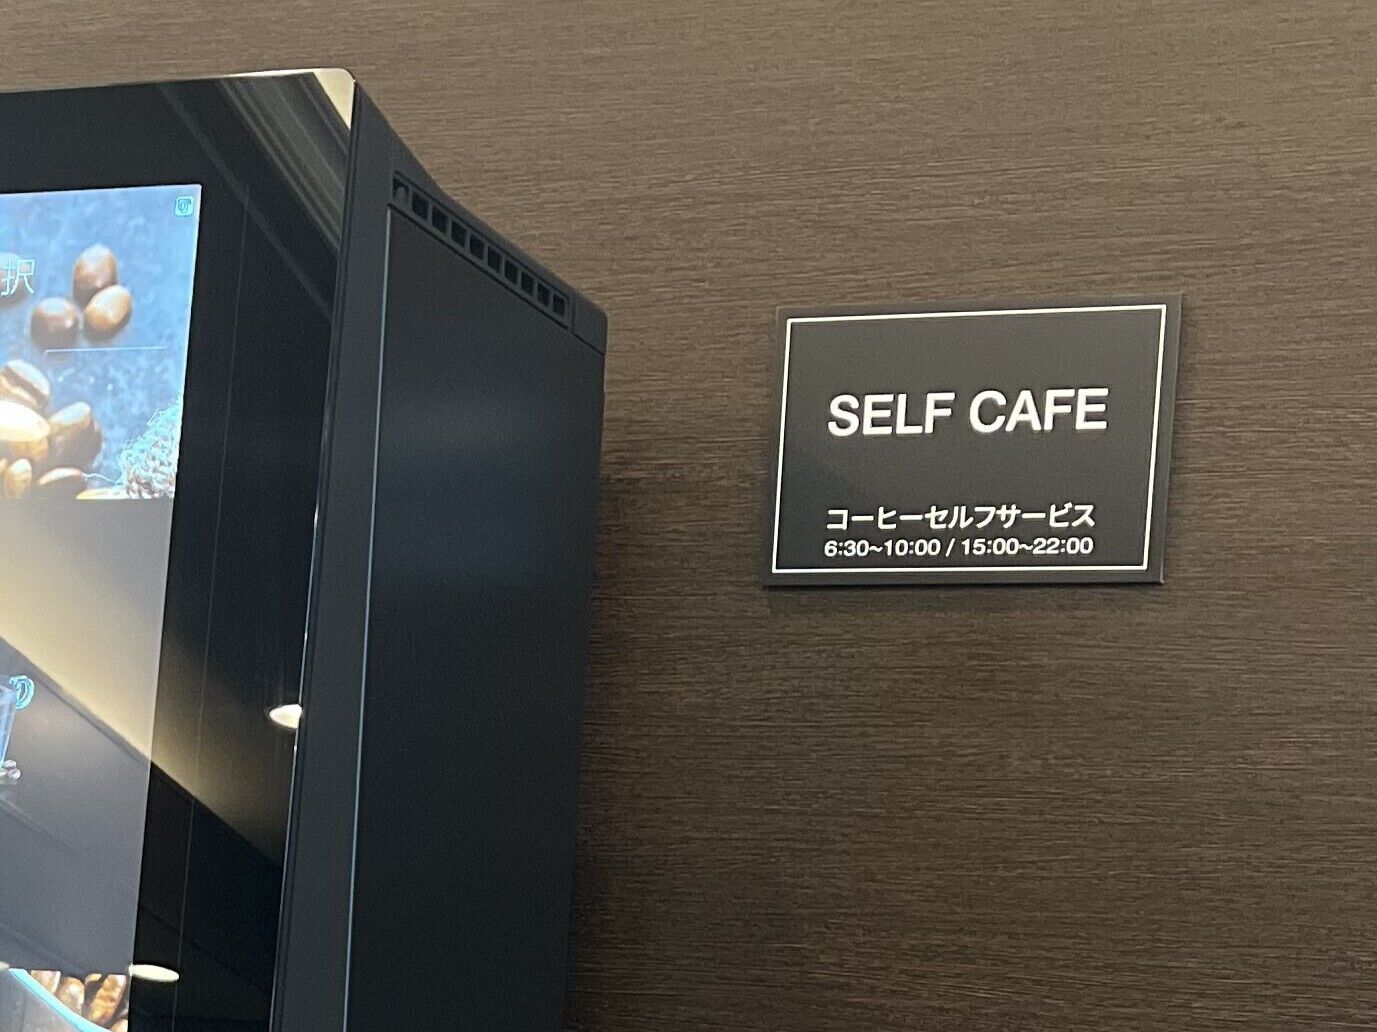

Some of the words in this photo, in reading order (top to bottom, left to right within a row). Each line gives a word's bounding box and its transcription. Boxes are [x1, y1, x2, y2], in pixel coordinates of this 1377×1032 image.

[827, 392, 956, 437] SELF
[969, 387, 1109, 434] CAFE
[826, 501, 1096, 532] コーヒーセルフサービス
[824, 537, 941, 558] 6:30~10:00
[961, 535, 1094, 557] 15:00~22:00
